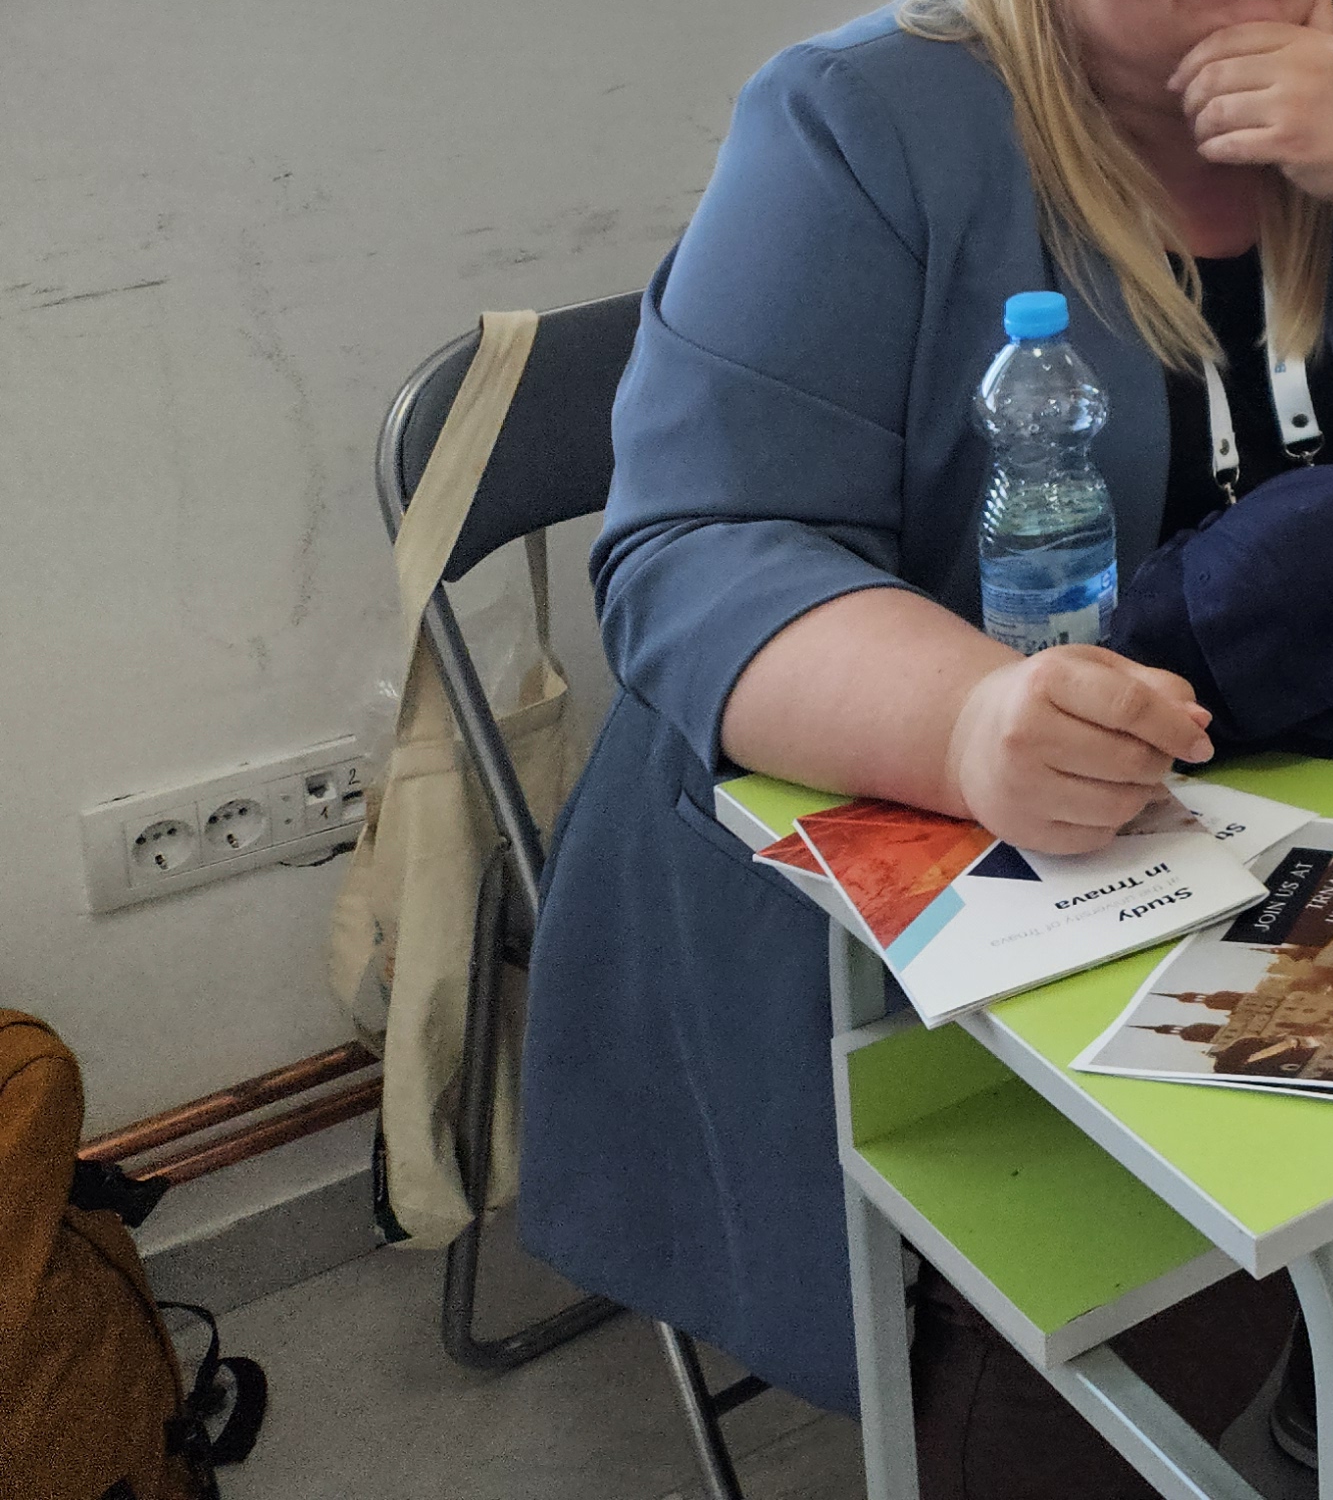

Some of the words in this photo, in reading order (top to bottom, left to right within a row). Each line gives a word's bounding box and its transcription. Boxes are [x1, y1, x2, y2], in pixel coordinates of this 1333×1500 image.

[348, 768, 361, 785] 2
[1145, 861, 1172, 876] in
[1054, 875, 1144, 910] Trnava
[1118, 886, 1194, 922] Study
[1254, 901, 1286, 932] JOIN
[1274, 880, 1300, 898] US
[1290, 862, 1314, 879] AT
[990, 927, 1042, 948] Trnava
